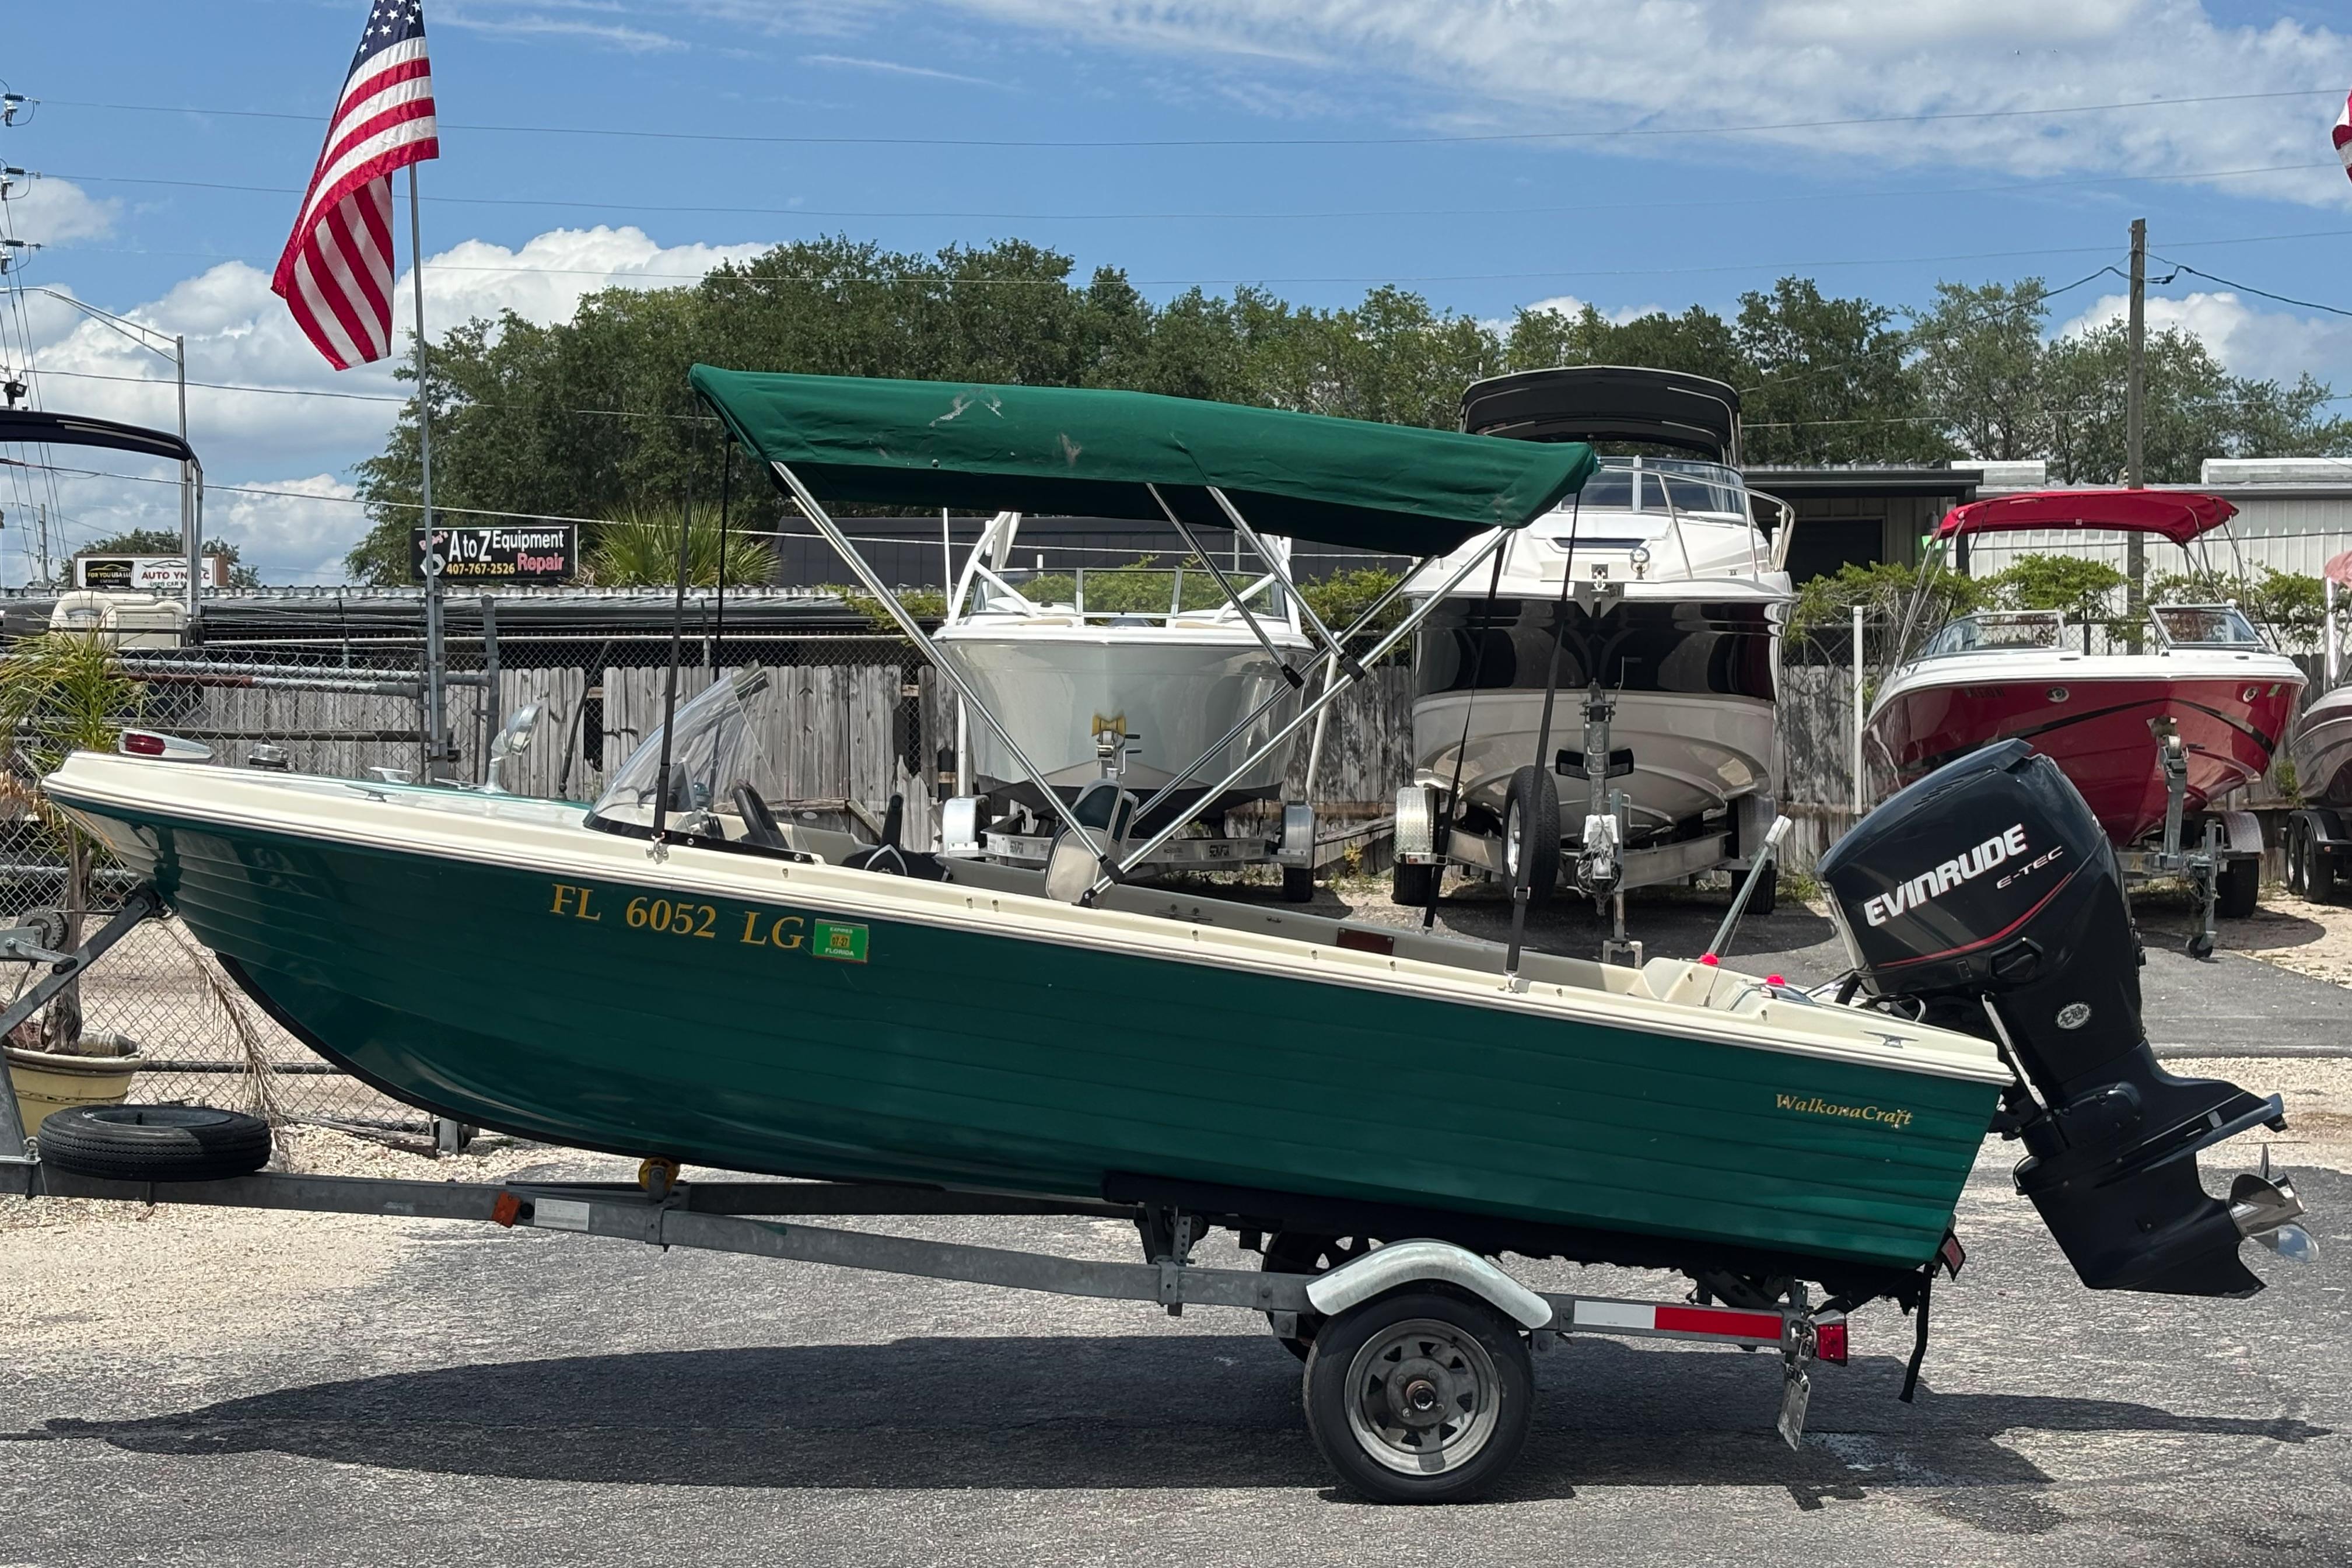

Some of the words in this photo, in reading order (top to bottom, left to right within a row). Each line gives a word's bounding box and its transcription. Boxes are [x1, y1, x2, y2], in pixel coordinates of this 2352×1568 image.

[449, 531, 462, 562] A
[463, 537, 477, 558] to
[479, 530, 492, 562] Z
[492, 530, 564, 552] Equipment
[446, 562, 515, 575] 407-767-2526
[517, 552, 565, 575] Repair
[142, 572, 170, 580] AUTO
[1863, 823, 2028, 927] EVINRUDE
[1996, 845, 2064, 890] E-TEC
[550, 883, 601, 921] FL
[626, 897, 717, 938] 6052
[740, 910, 804, 949] LG
[825, 947, 854, 956] FLORIDA
[832, 937, 849, 947] 07-27
